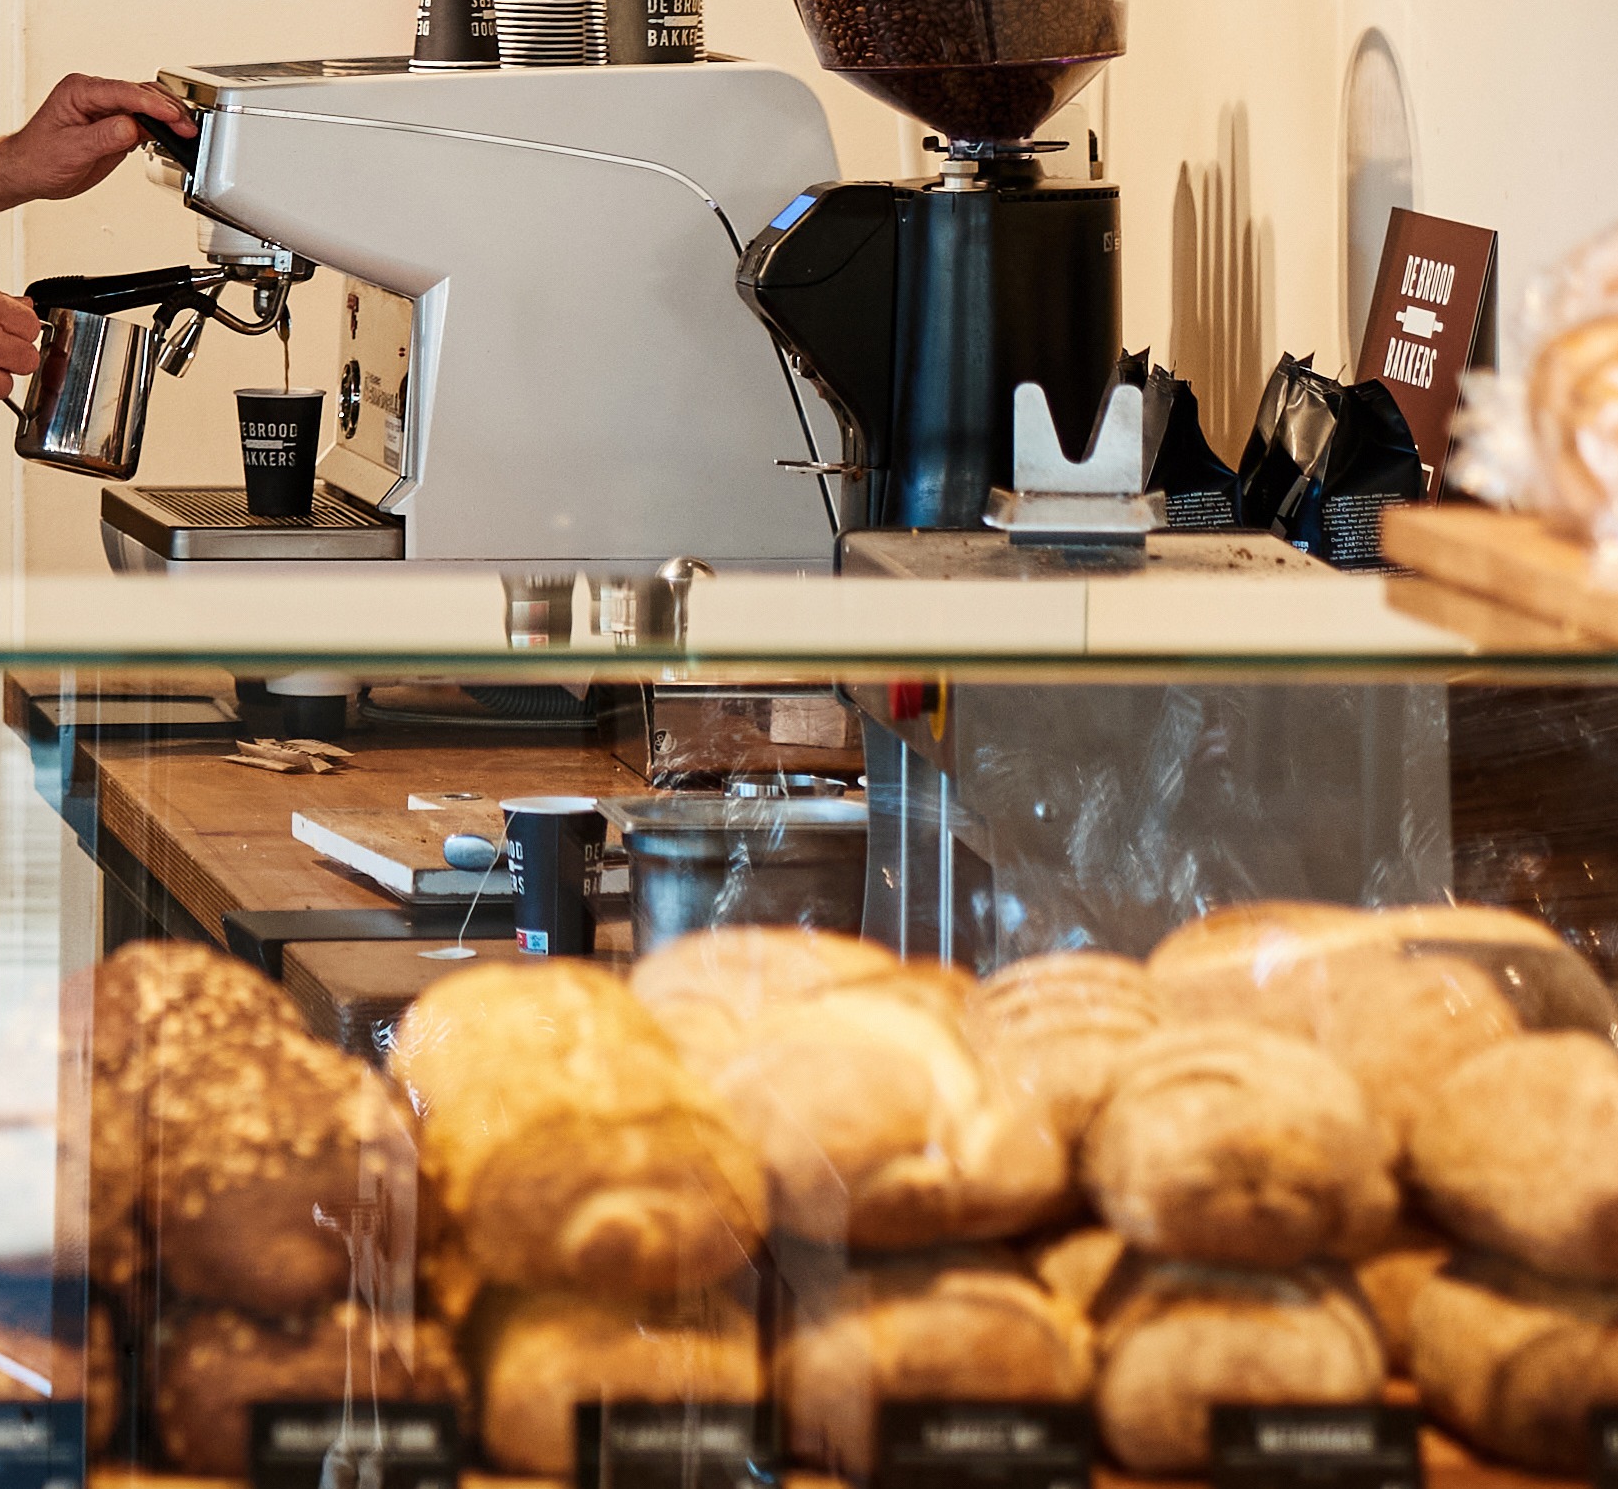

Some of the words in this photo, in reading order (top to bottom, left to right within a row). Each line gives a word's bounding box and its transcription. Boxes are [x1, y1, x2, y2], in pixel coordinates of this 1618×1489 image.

[1401, 254, 1421, 297] DE
[1415, 258, 1456, 306] BROOD
[1383, 337, 1438, 390] BAKKERS
[248, 422, 298, 438] BROOD
[245, 451, 297, 467] AKKERS
